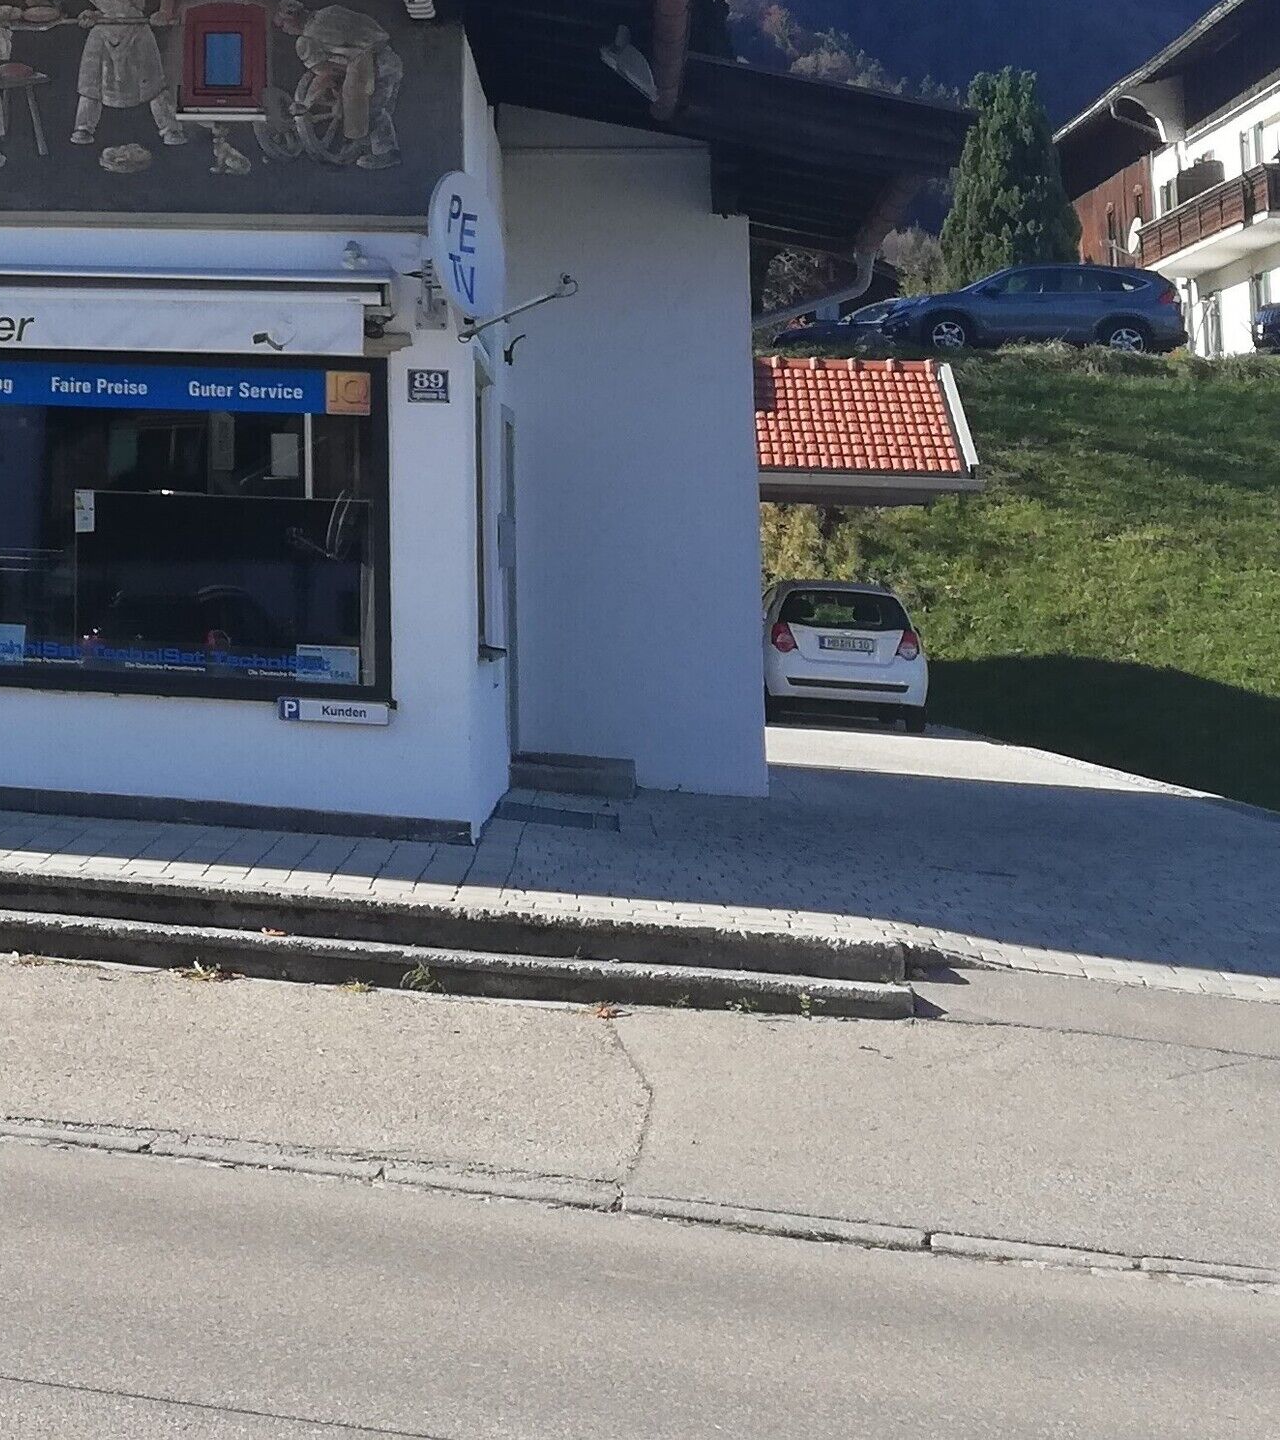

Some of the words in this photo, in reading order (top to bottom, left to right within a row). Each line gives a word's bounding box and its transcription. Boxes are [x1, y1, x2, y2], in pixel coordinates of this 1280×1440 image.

[51, 376, 92, 394] Faire
[96, 378, 148, 396] Preise
[188, 380, 233, 398] Guter
[238, 382, 304, 399] Service
[414, 372, 443, 388] 89
[283, 700, 297, 718] P
[321, 705, 367, 718] Kunden
